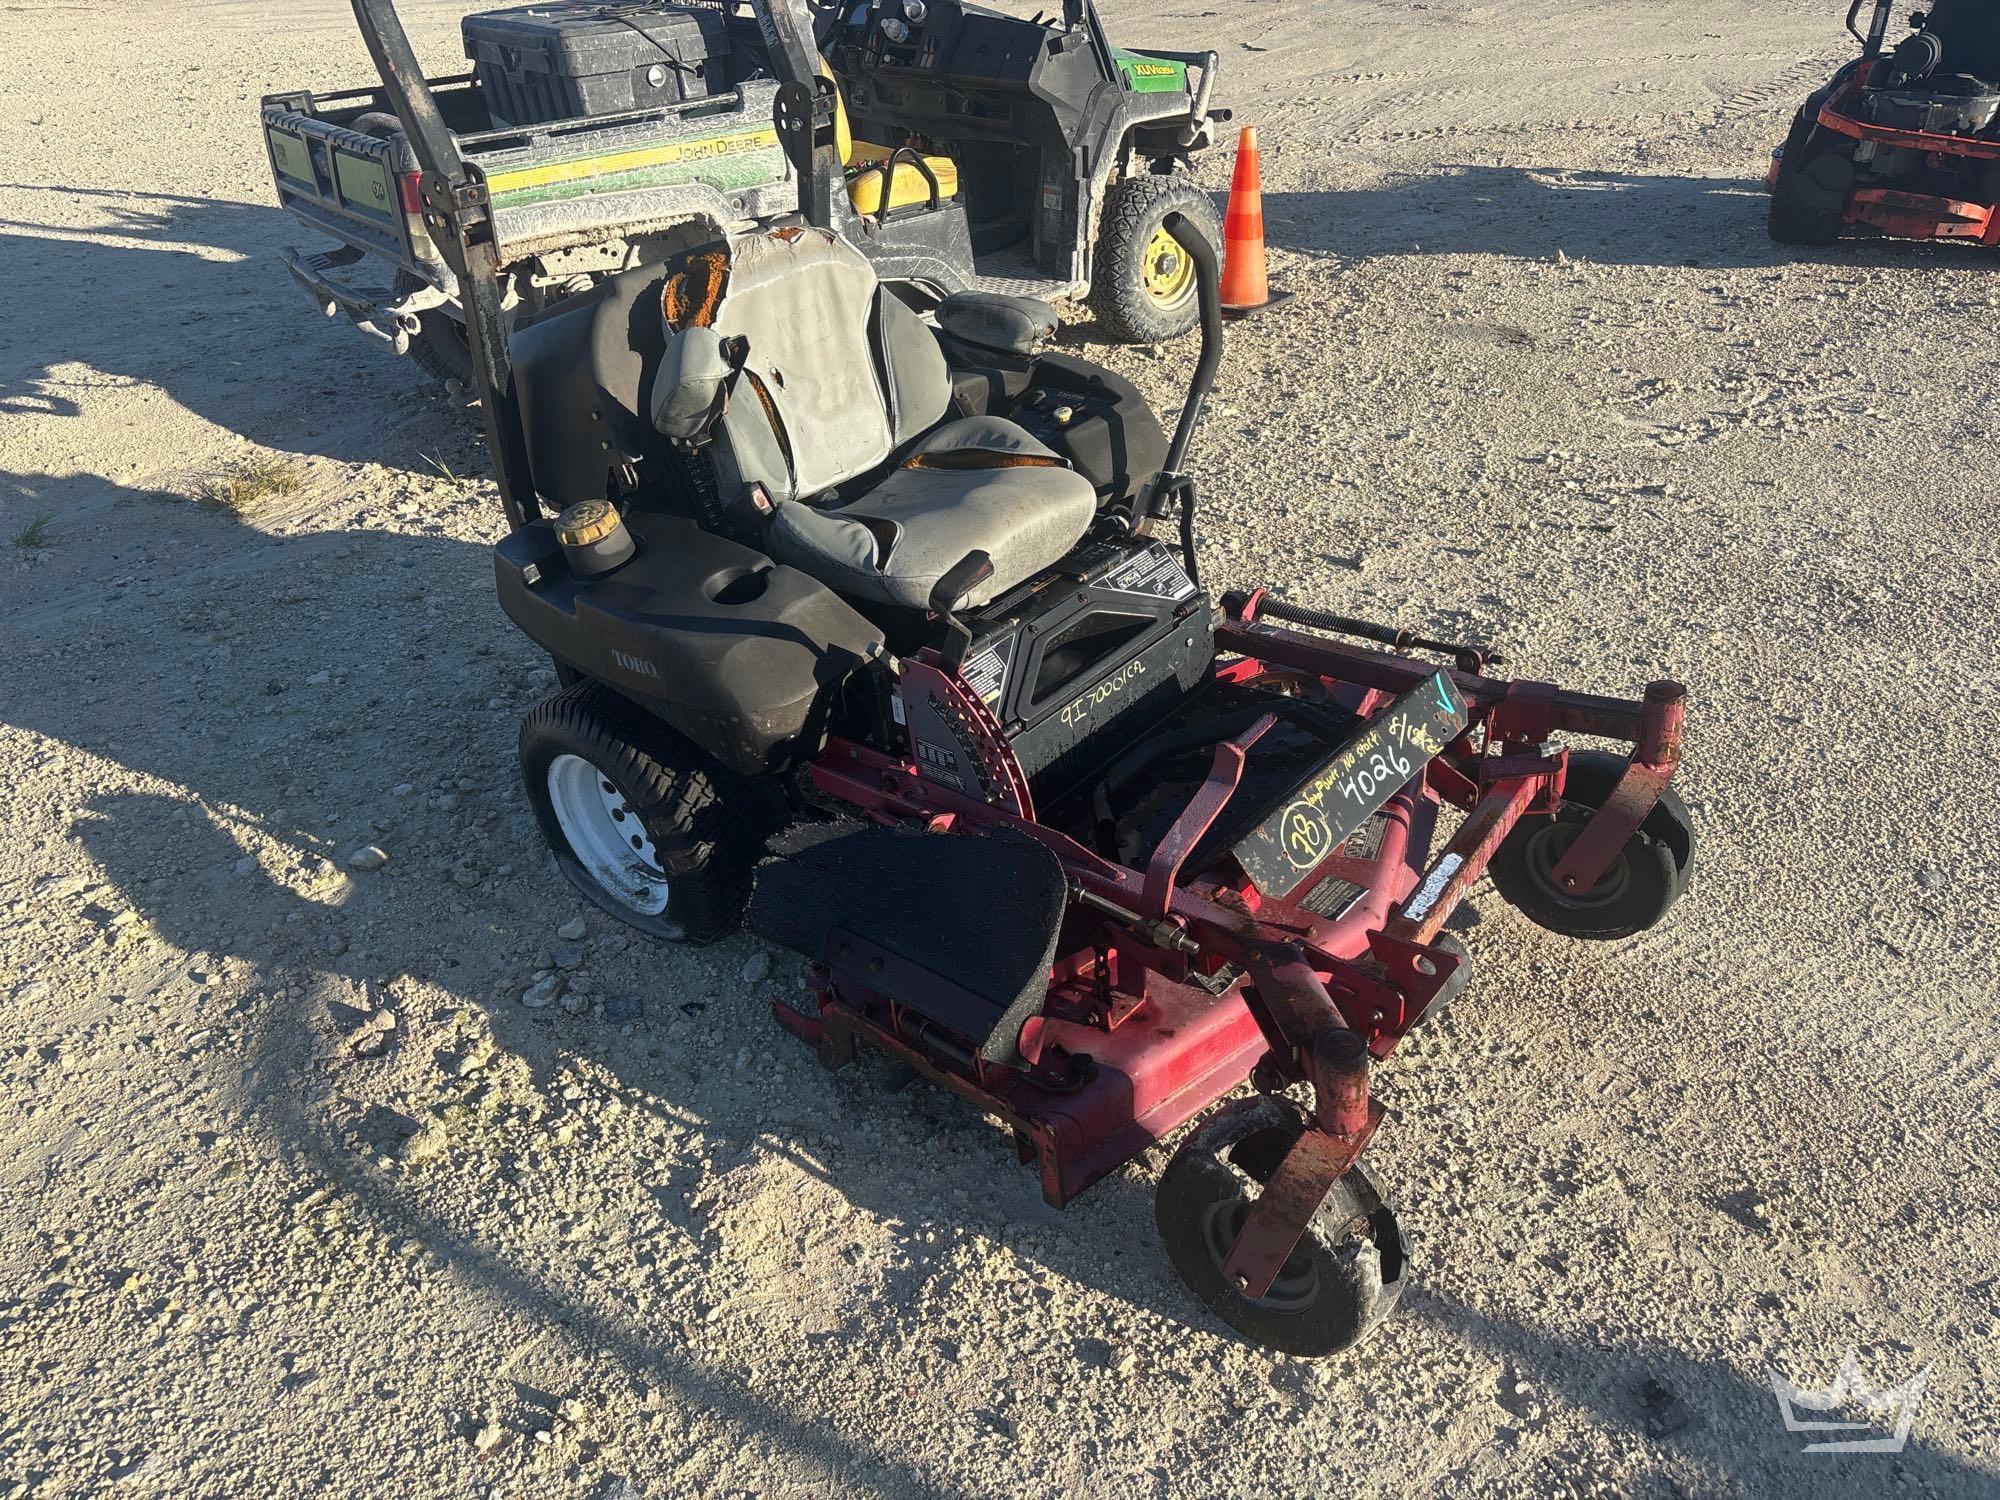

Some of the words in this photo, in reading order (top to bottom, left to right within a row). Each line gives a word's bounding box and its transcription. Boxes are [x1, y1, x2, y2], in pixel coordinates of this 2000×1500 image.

[676, 144, 713, 160] JOHN
[716, 136, 761, 154] DEERE
[609, 648, 658, 678] TORO
[1337, 745, 1411, 806] 4026
